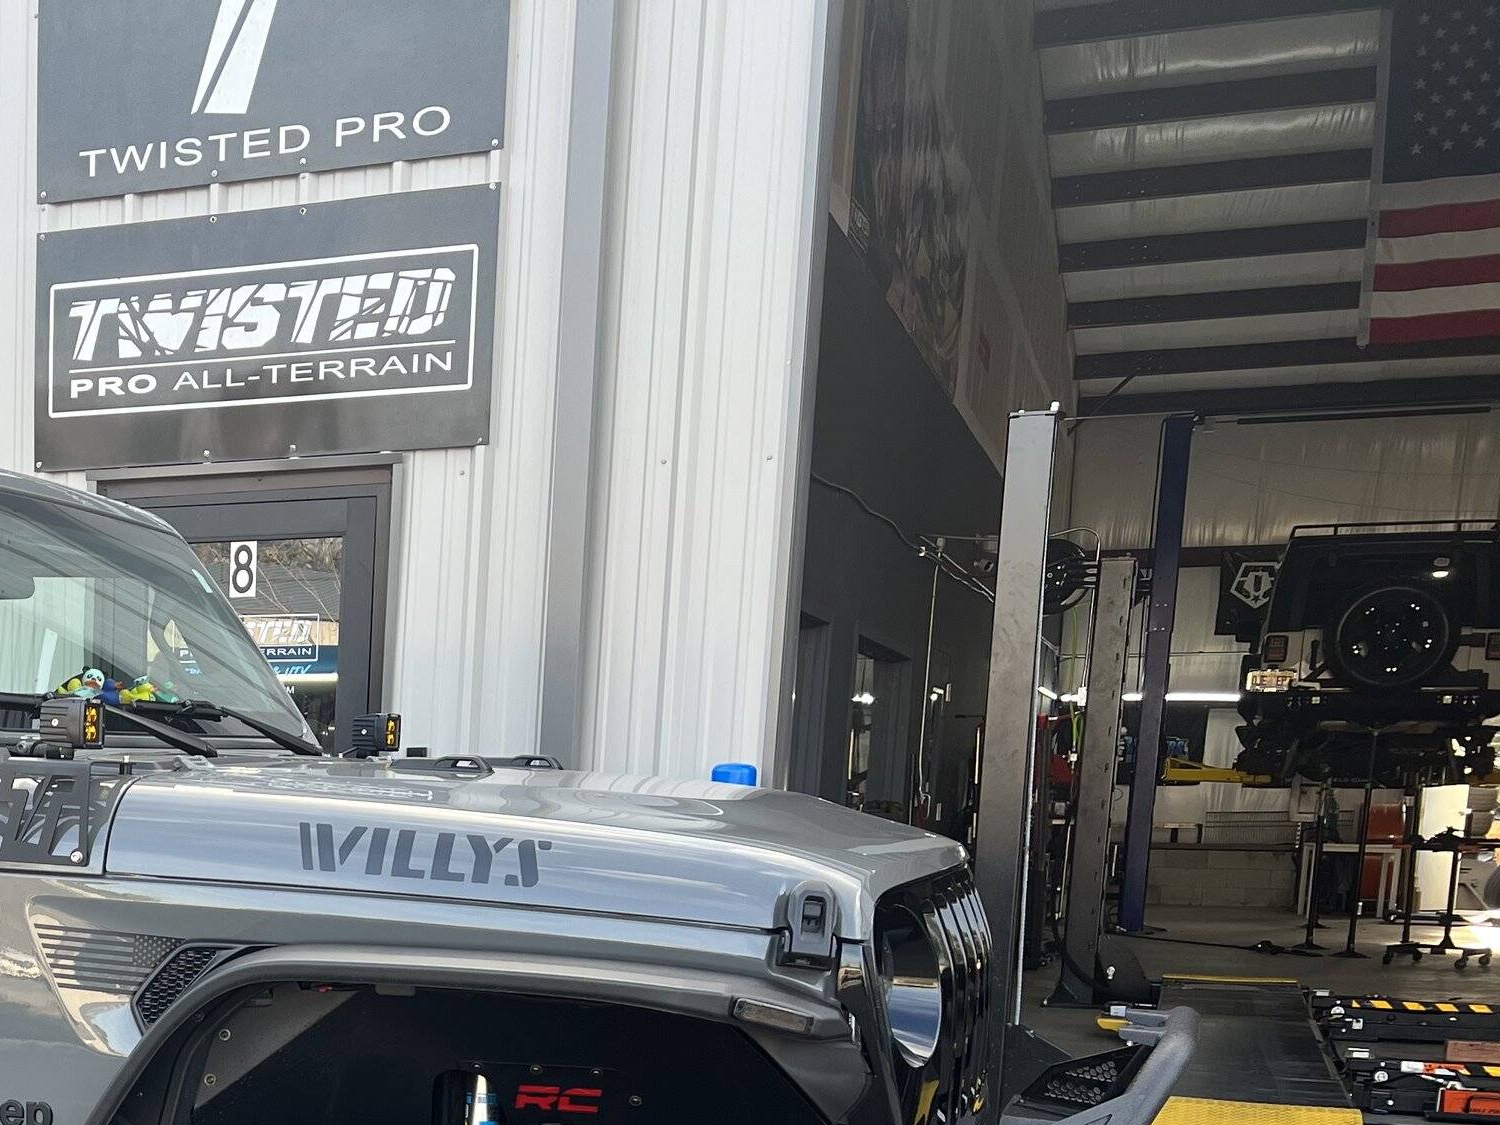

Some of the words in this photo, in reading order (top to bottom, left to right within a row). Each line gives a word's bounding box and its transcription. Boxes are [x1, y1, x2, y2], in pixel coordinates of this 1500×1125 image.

[79, 124, 311, 177] TWISTED
[334, 106, 451, 147] PRO
[68, 267, 456, 362] TWISTED
[69, 373, 157, 399] PRO
[172, 351, 453, 391] ALL-TERRAIN
[232, 544, 254, 594] 8
[299, 822, 552, 888] WILLYS
[515, 1084, 603, 1114] RC
